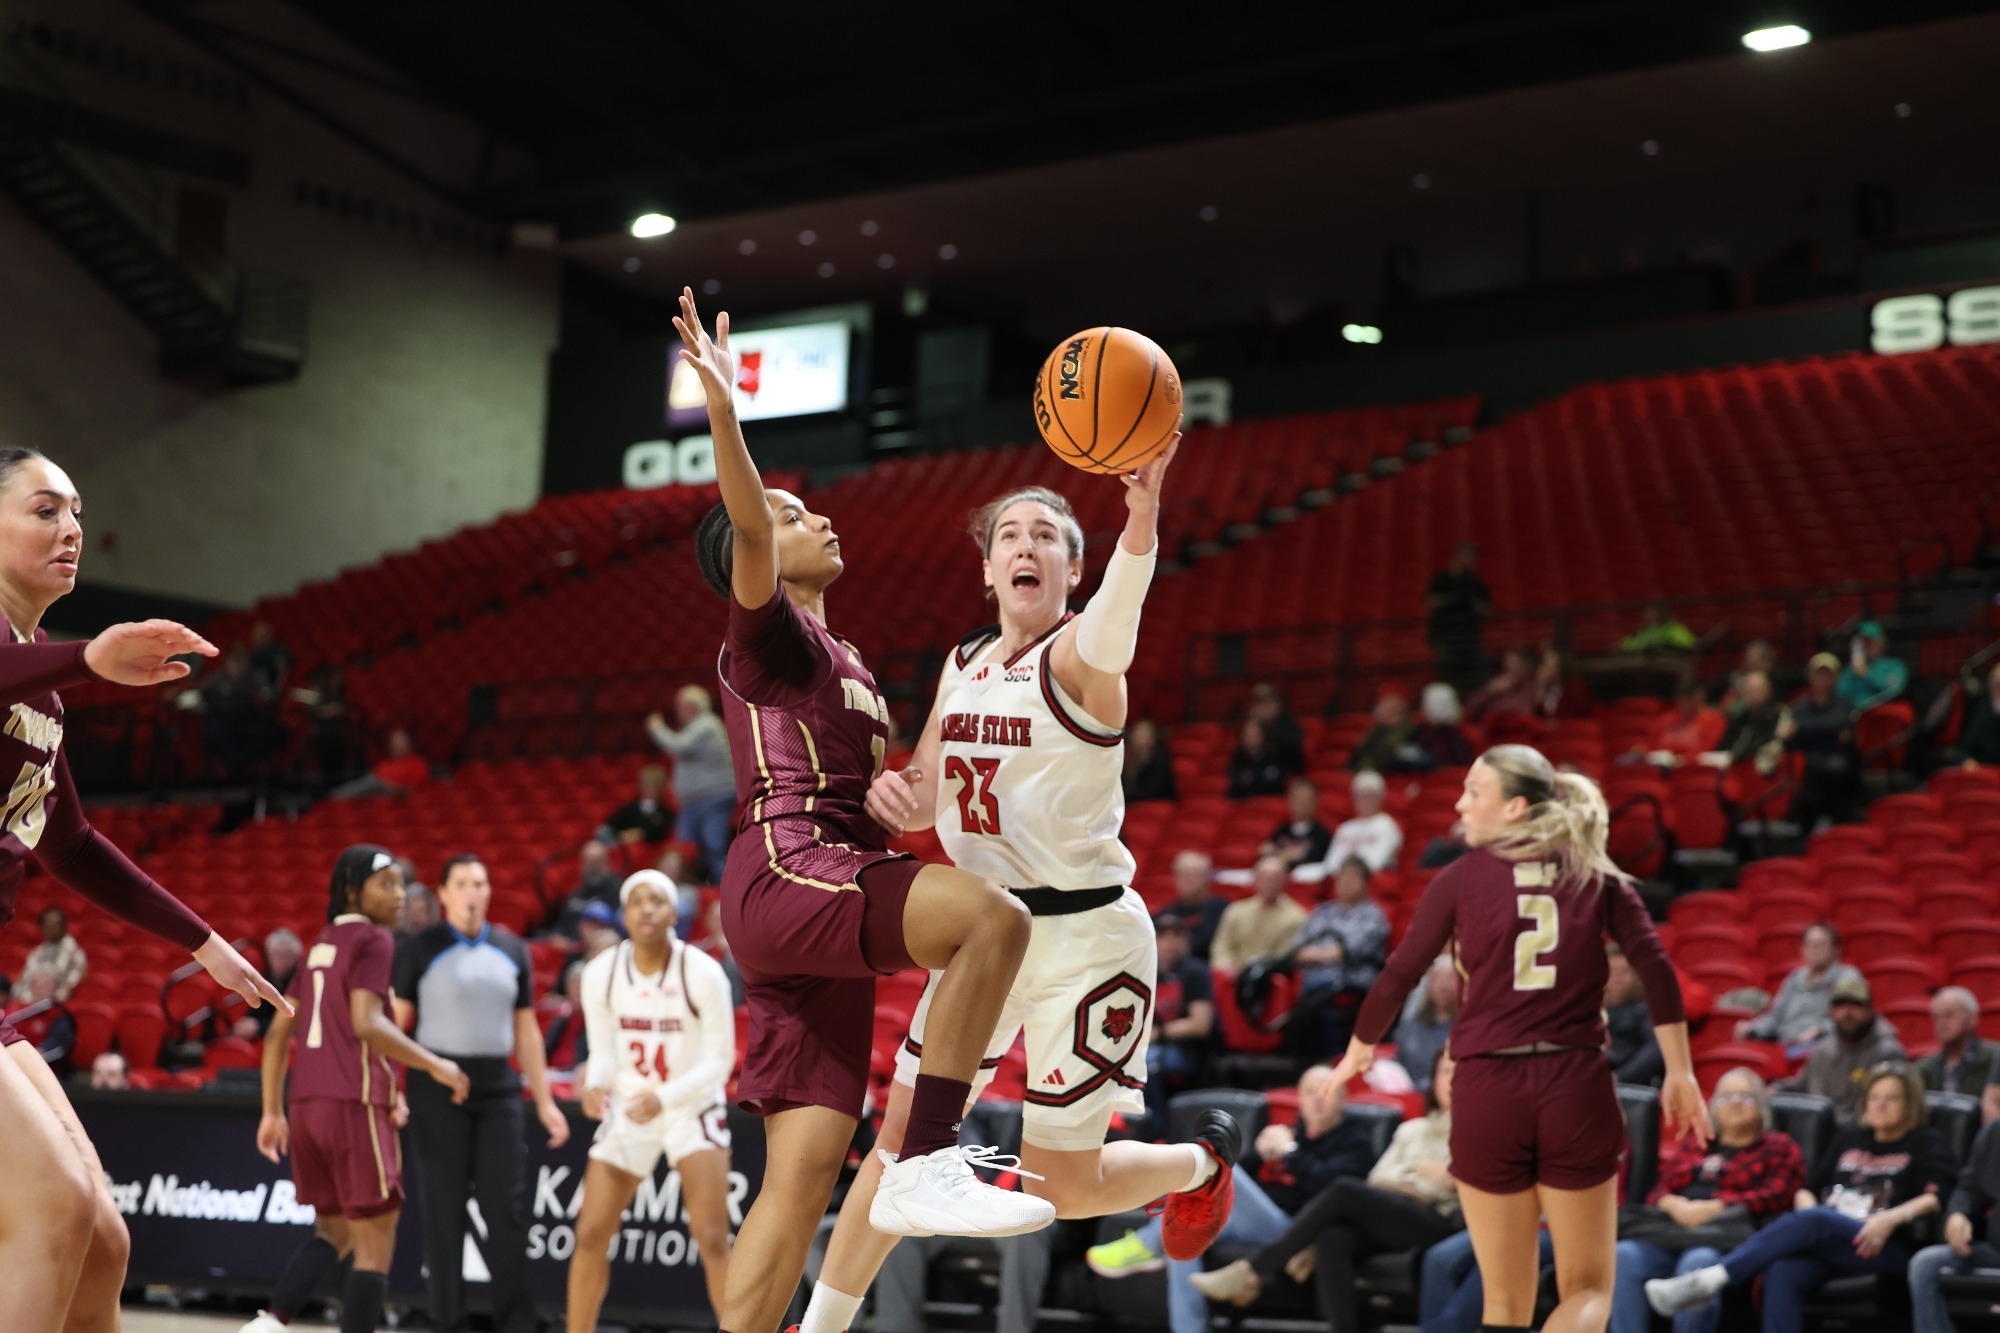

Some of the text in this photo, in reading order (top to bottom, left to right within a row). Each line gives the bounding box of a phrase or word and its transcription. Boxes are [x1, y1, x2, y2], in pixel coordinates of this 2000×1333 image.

[1871, 286, 2000, 355] SS
[1060, 337, 1089, 400] NCAA
[982, 715, 1031, 747] STATE
[945, 755, 1002, 836] 23
[1512, 893, 1559, 991] 2
[306, 969, 325, 1049] 1
[629, 1041, 670, 1083] 24
[141, 1172, 268, 1223] National
[532, 1164, 750, 1227] KMR
